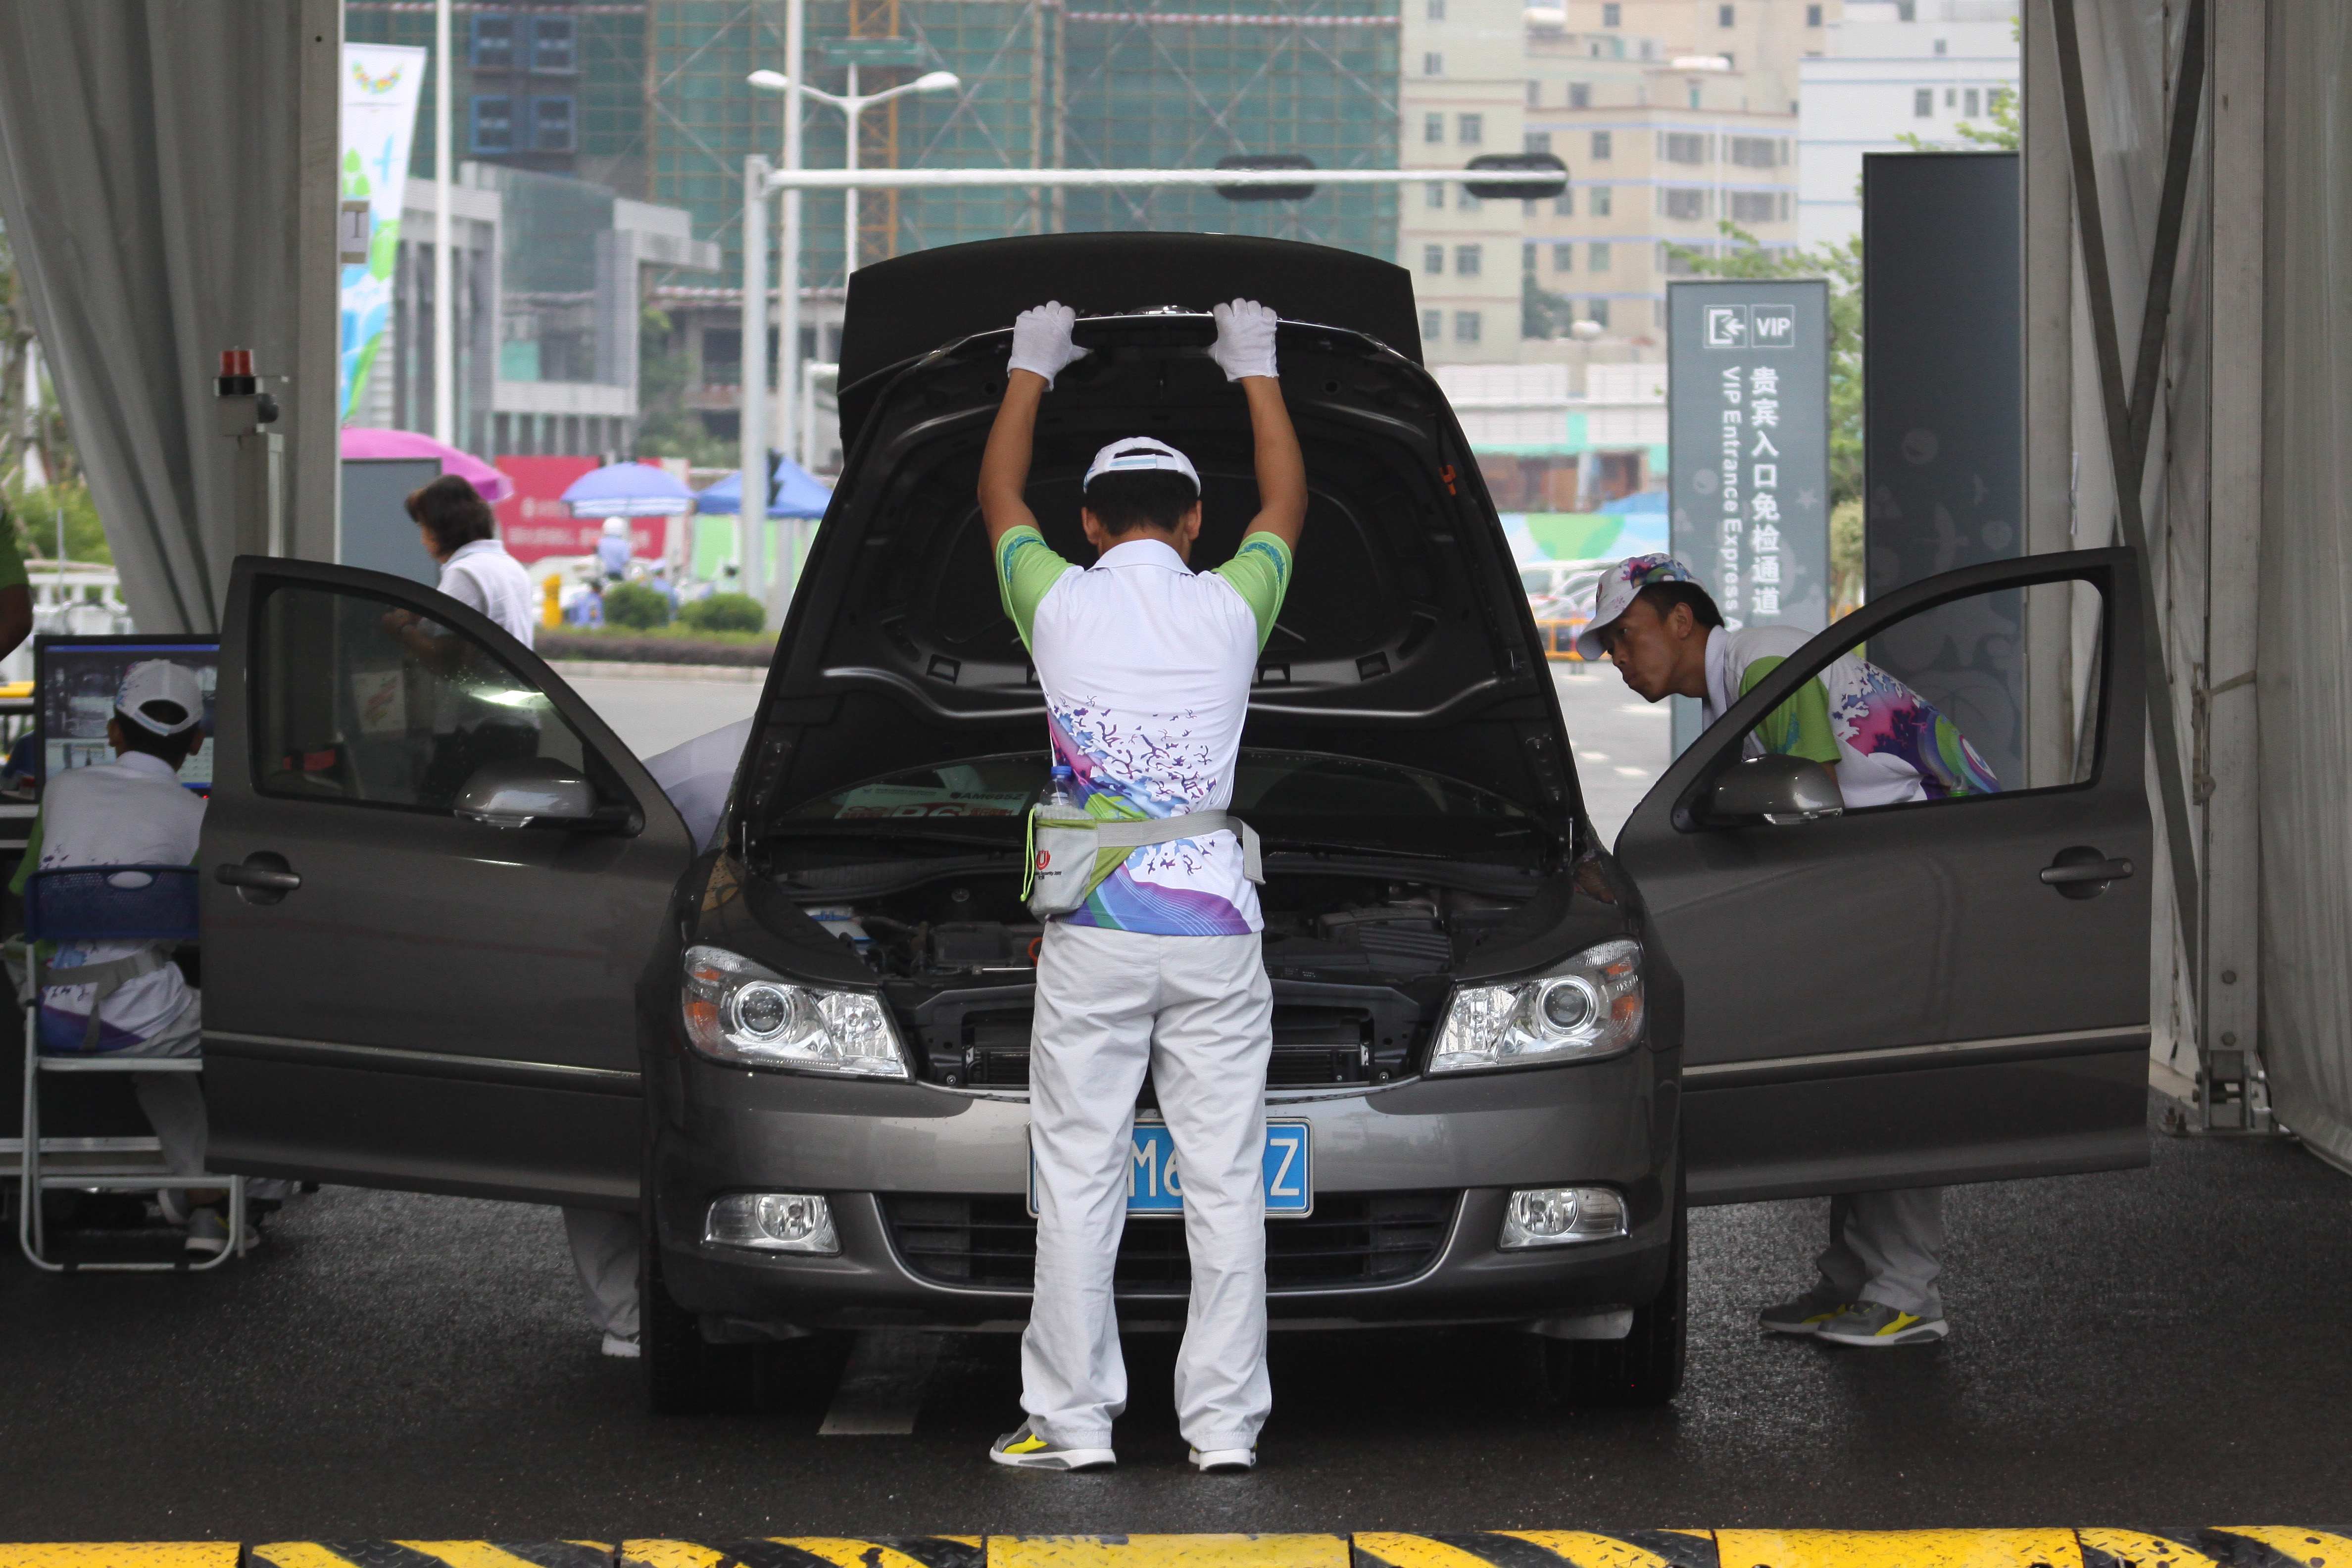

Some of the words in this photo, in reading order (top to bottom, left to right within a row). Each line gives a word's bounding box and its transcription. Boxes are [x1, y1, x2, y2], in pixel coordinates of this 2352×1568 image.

[1757, 317, 1791, 336] VIP
[1721, 366, 1742, 404] VIP
[1721, 410, 1742, 512] Entrance
[1750, 366, 1780, 615] 贵宾入口免检通道
[1719, 518, 1743, 611] Express
